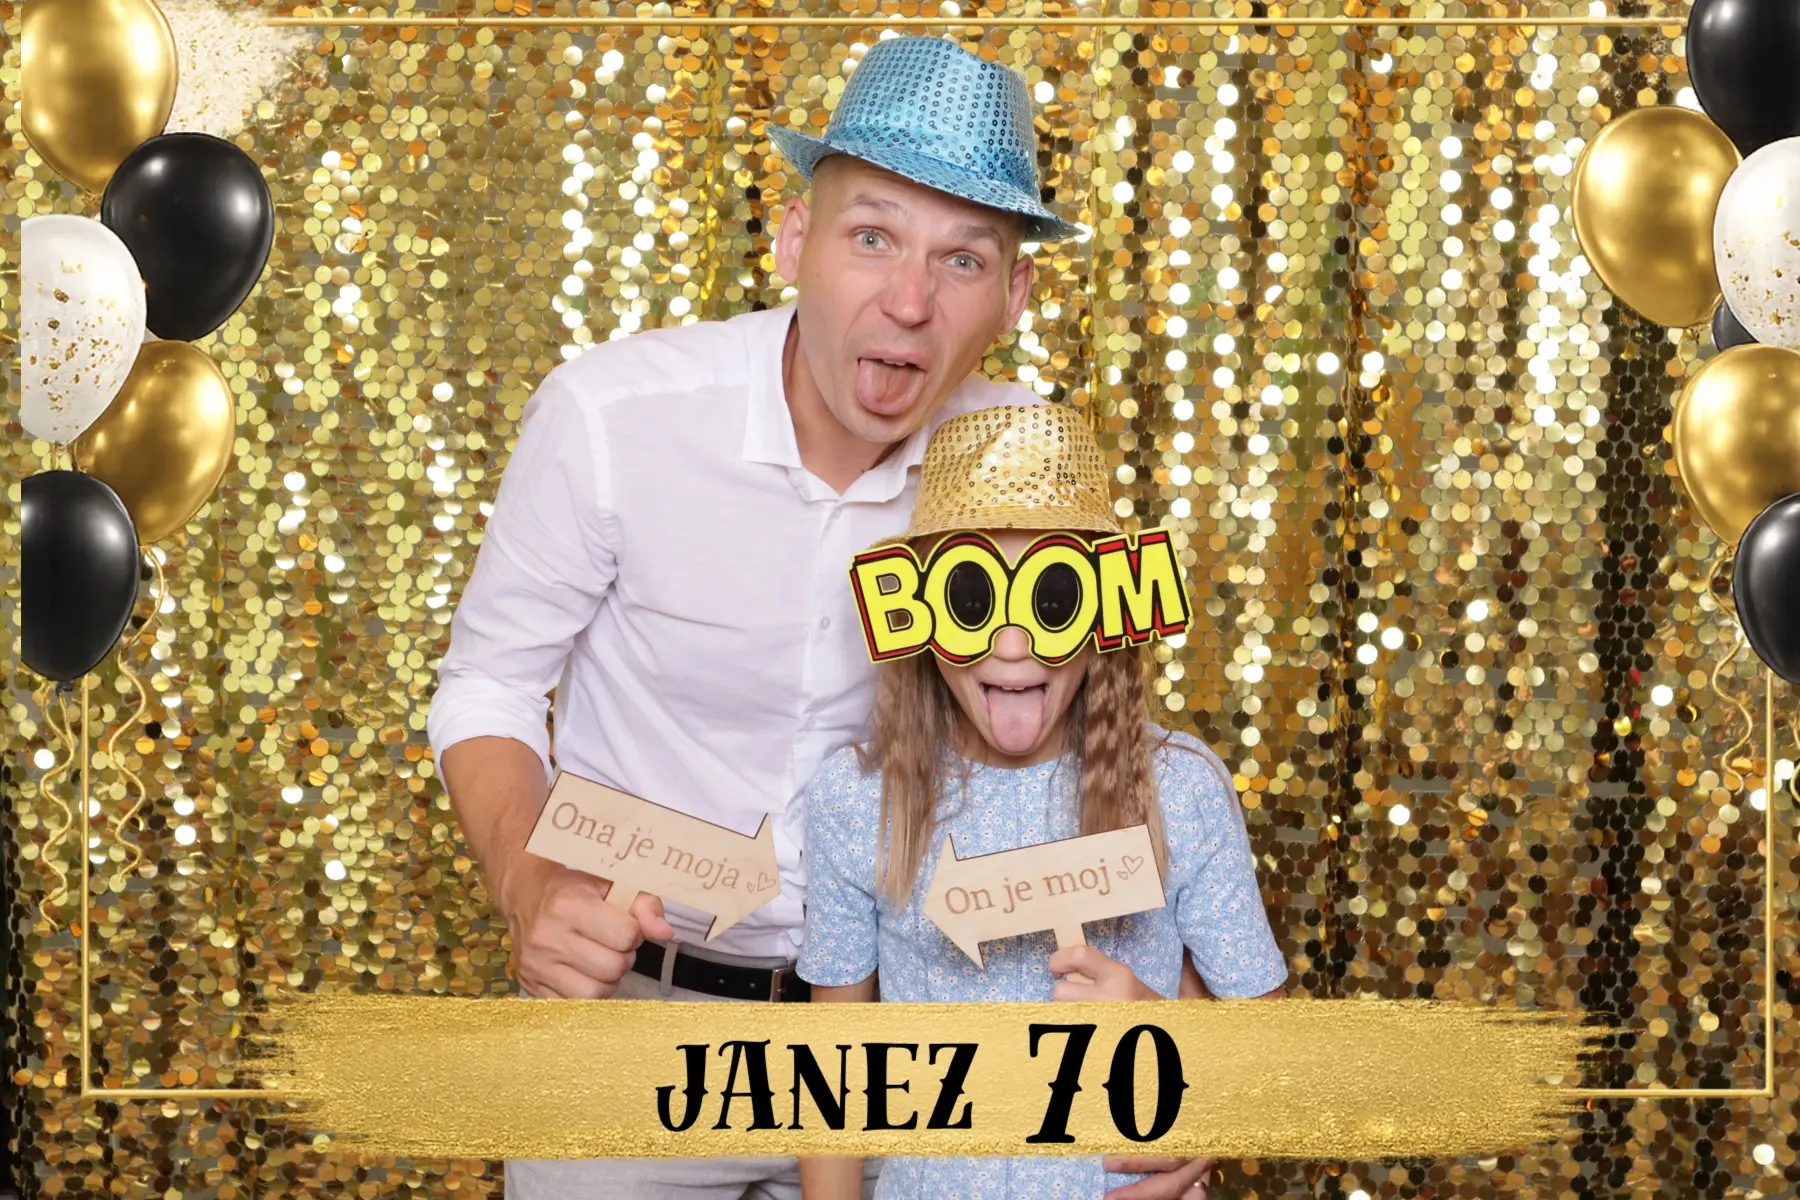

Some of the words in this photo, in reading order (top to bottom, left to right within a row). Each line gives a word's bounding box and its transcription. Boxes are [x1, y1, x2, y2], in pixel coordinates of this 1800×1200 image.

[850, 528, 1192, 664] BOOM
[551, 802, 616, 846] Ona
[615, 827, 654, 860] je
[660, 844, 741, 890] moja
[945, 886, 995, 914] On
[1003, 877, 1033, 913] je
[1043, 858, 1111, 895] moj
